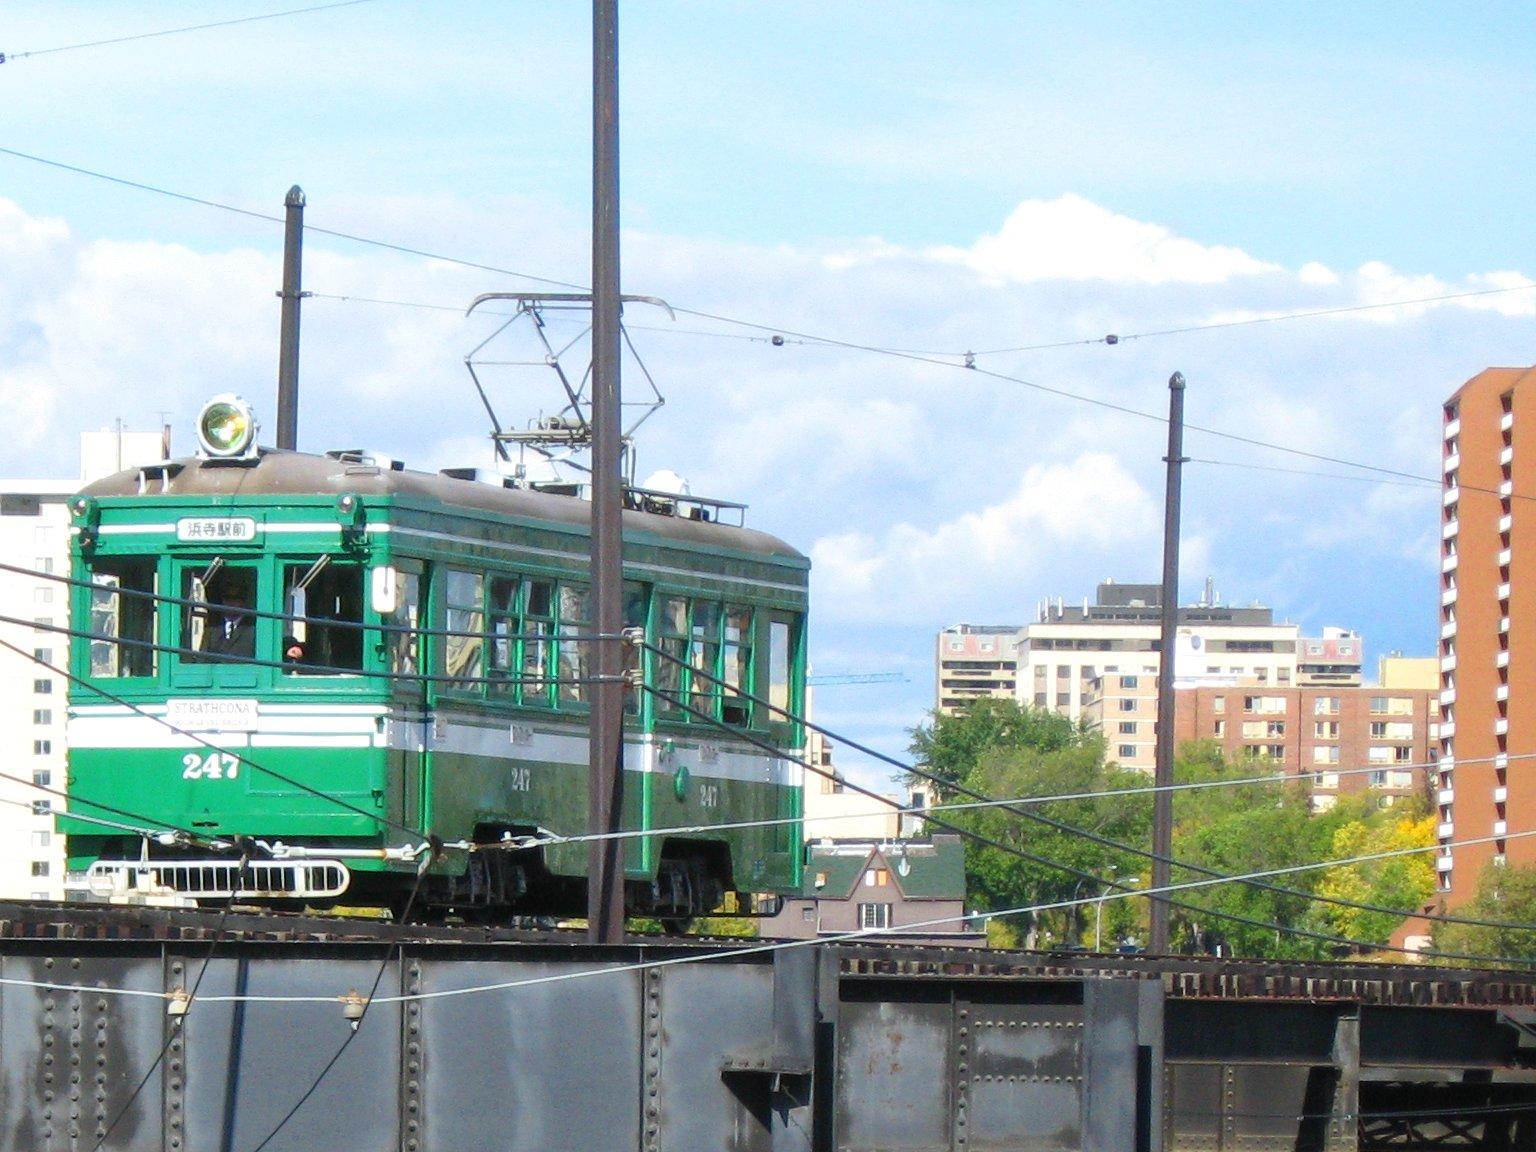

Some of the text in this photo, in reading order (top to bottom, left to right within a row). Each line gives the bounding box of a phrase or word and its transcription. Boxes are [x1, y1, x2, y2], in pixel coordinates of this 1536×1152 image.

[175, 702, 250, 714] STRATHCONA
[182, 752, 240, 779] 247
[511, 767, 531, 792] 247
[700, 784, 718, 807] 247
